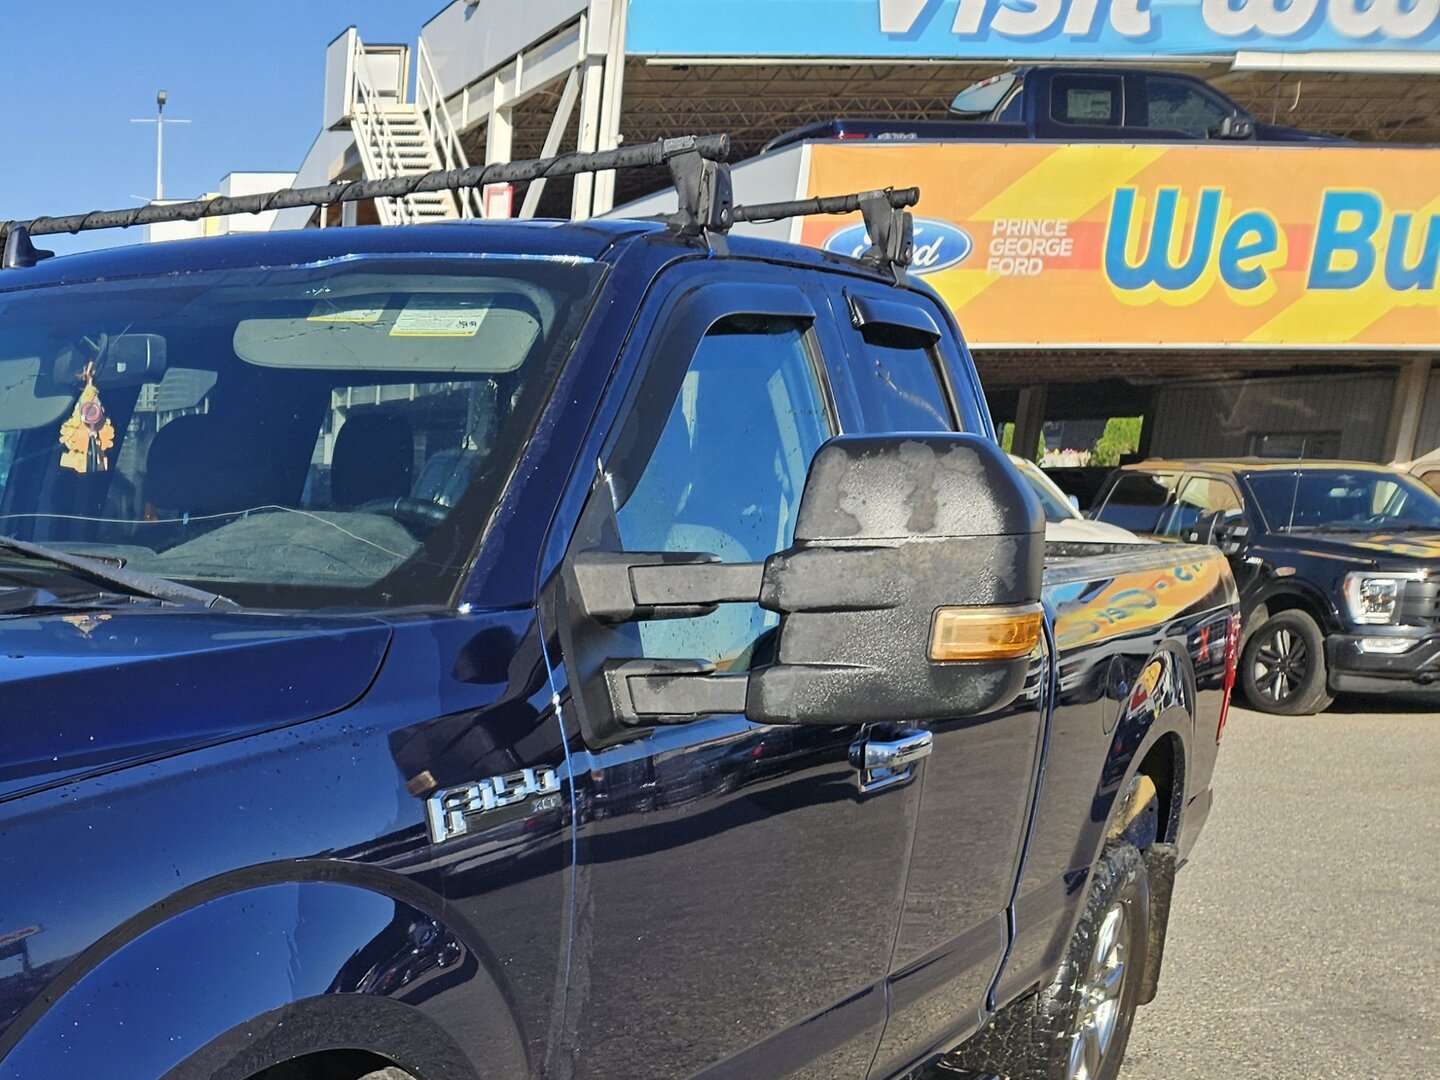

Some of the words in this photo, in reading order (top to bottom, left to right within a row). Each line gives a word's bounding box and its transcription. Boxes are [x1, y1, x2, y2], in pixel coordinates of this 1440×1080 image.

[991, 219, 1068, 237] PRINCE
[988, 238, 1073, 257] GEORGE
[1105, 187, 1278, 290] We
[1306, 189, 1440, 291] Bu
[986, 257, 1043, 277] FORD
